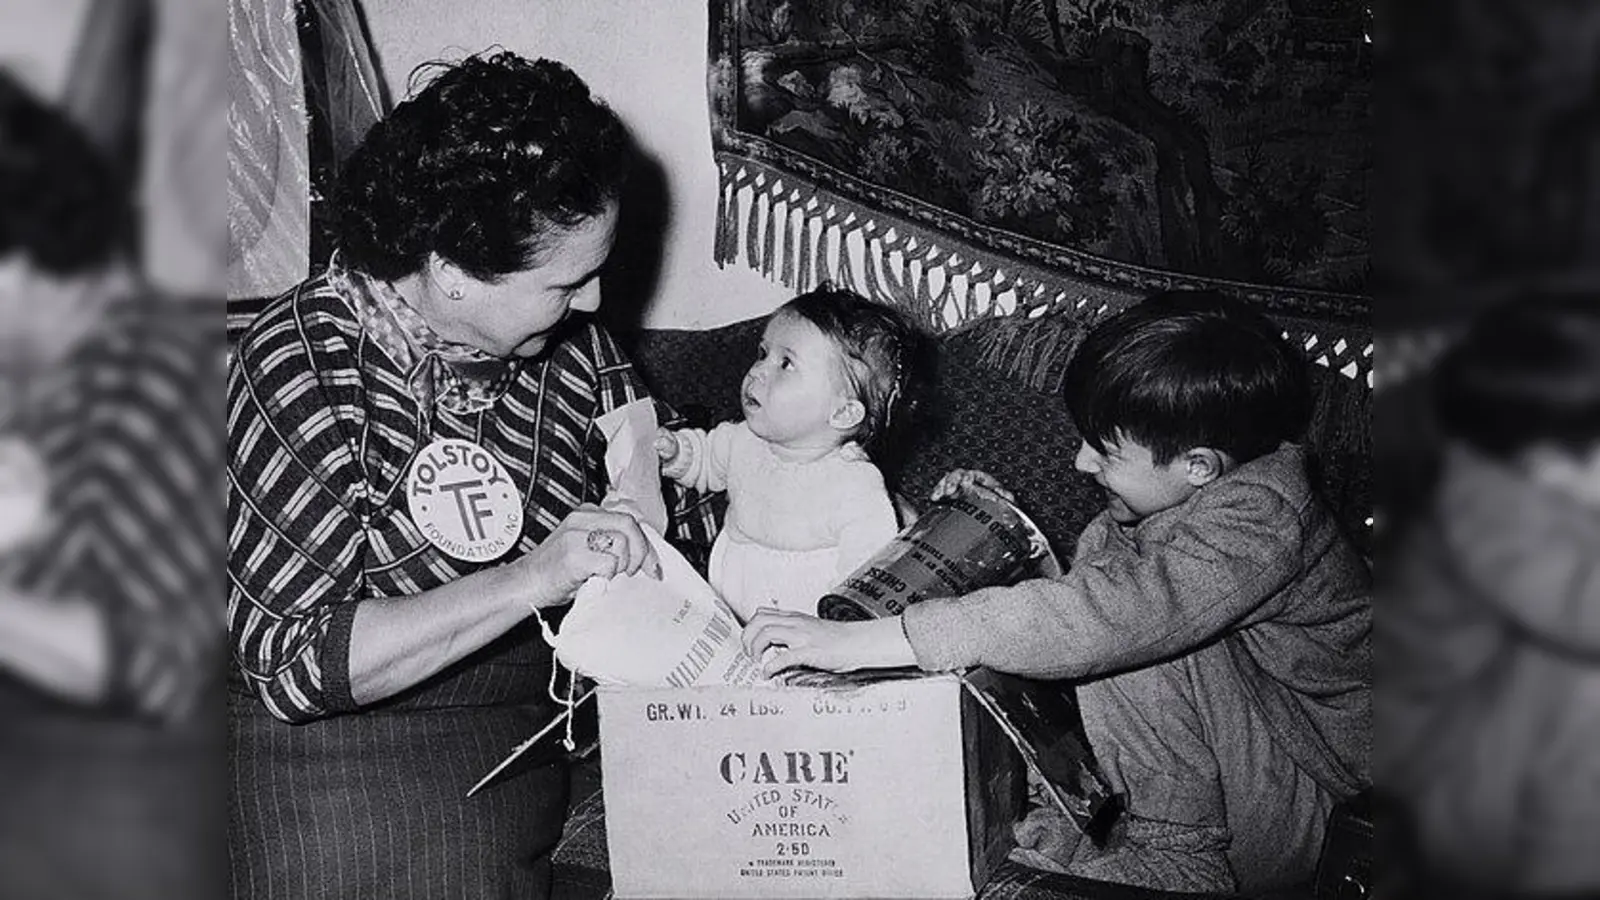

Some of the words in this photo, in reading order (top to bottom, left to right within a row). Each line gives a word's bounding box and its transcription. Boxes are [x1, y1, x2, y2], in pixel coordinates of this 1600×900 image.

[413, 444, 509, 497] TOLSTOY
[424, 522, 505, 557] FOUNDATION
[719, 751, 849, 785] CARE
[726, 788, 782, 825] UITED
[778, 805, 798, 819] OF
[751, 822, 832, 838] AMERICA
